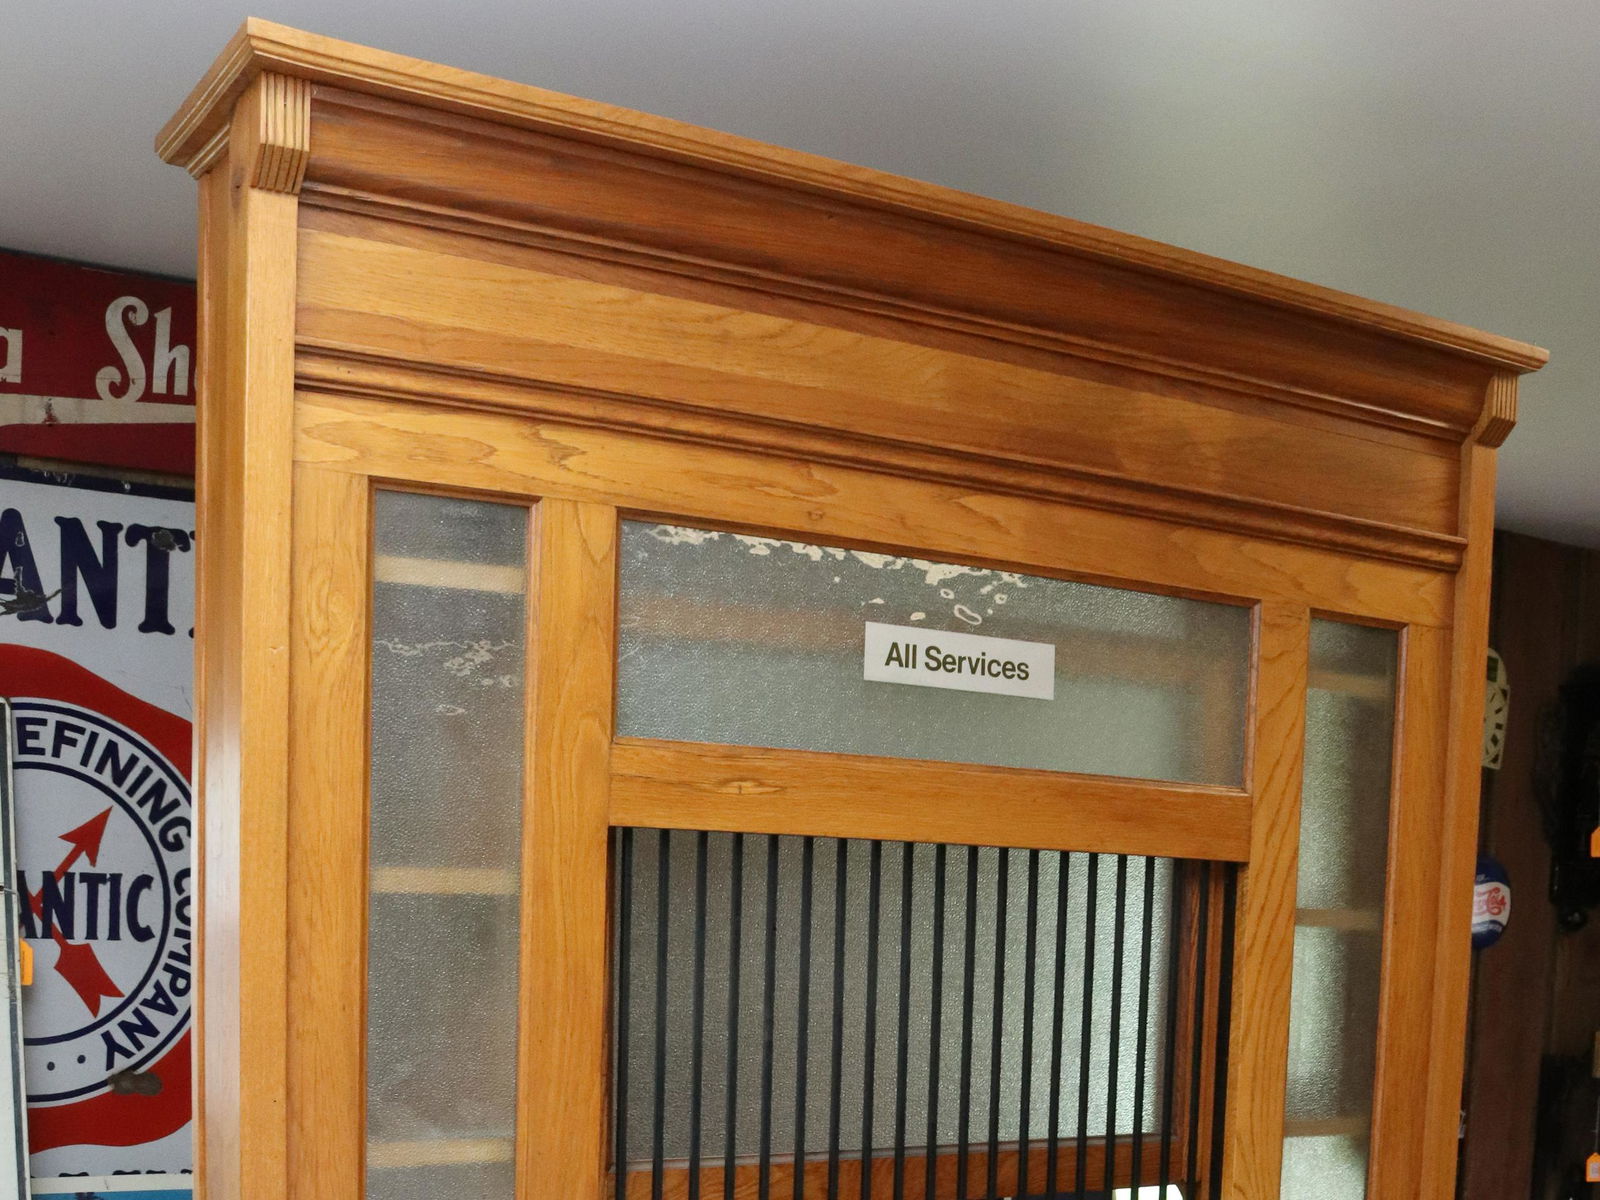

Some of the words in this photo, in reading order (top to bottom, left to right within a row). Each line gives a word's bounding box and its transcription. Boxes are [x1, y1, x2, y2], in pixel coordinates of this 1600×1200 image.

[96, 296, 196, 402] Sh
[0, 508, 195, 638] ANT
[885, 641, 917, 669] All
[924, 645, 1030, 681] Services
